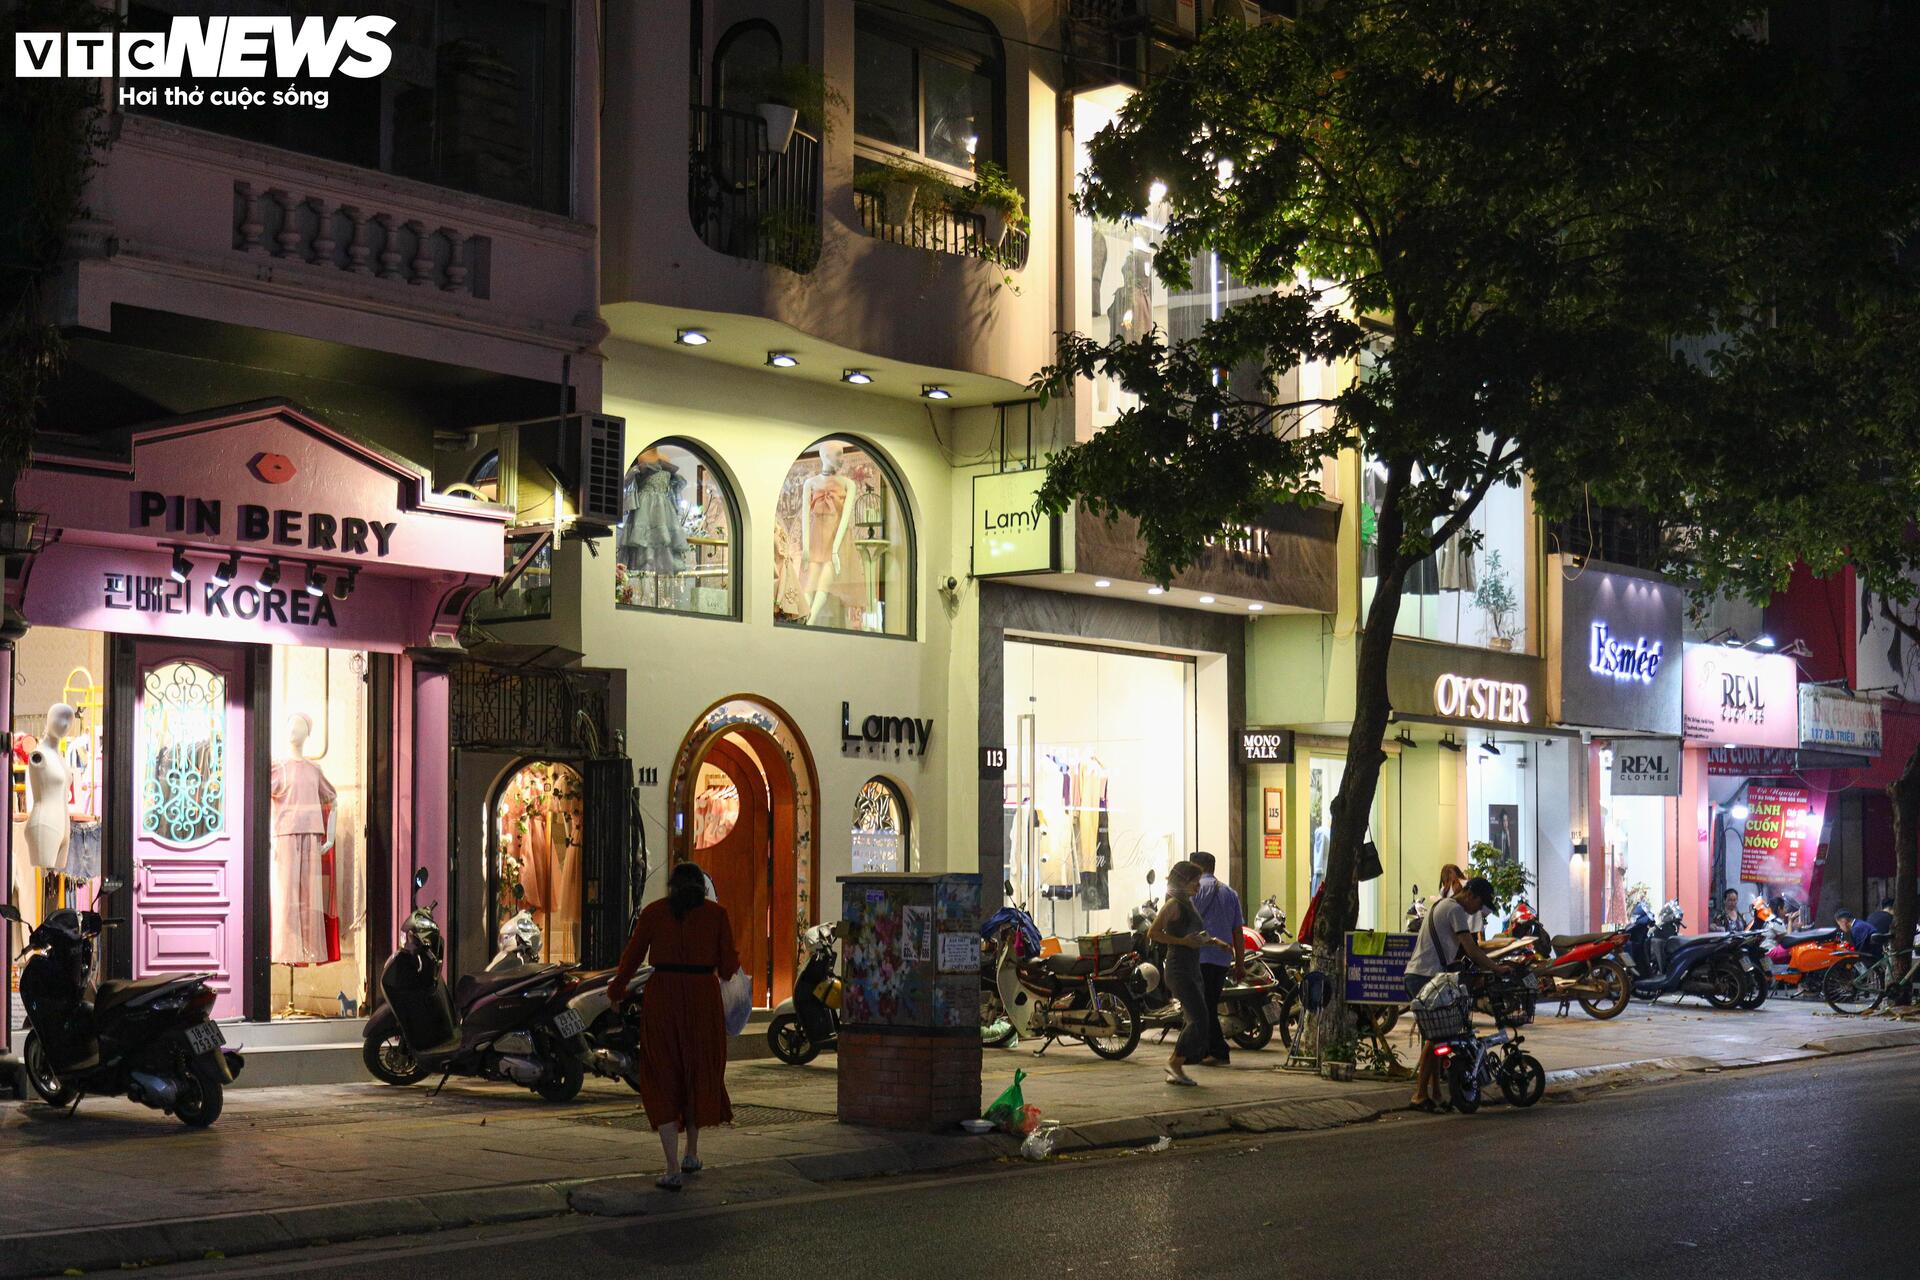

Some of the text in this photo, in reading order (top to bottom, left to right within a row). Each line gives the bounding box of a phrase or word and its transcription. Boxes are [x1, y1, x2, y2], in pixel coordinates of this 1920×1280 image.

[130, 491, 397, 557] PIN BERRY
[985, 509, 1040, 530] Lamy
[104, 573, 191, 614] 핀베리
[205, 582, 337, 627] KOREA
[1434, 673, 1530, 723] OYSTER
[1721, 673, 1765, 710] REAL
[842, 701, 933, 755] Lamy
[1244, 735, 1281, 747] MONO
[986, 750, 1003, 767] 113
[1245, 747, 1278, 759] TALK
[1620, 755, 1669, 773] REAL
[639, 766, 658, 784] 111
[1268, 808, 1279, 818] 115
[1748, 801, 1781, 816] BÁNH
[1745, 816, 1779, 832] CUỐN
[1744, 834, 1779, 849] NÓNG
